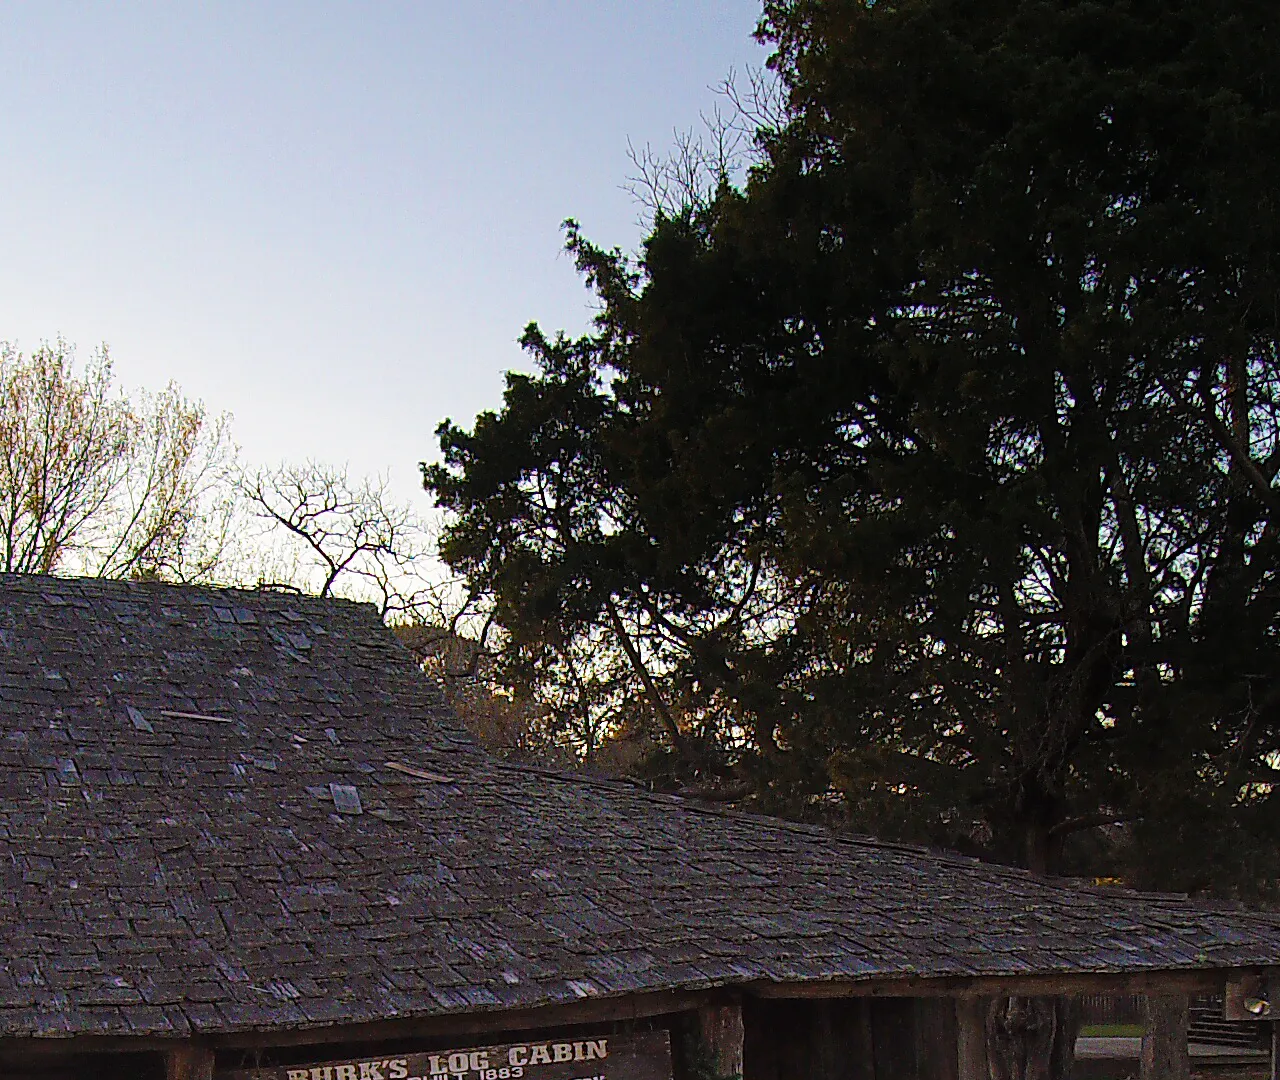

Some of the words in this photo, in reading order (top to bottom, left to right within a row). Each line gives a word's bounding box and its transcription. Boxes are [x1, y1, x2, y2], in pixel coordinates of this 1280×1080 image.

[428, 1051, 489, 1076] LOG
[508, 1039, 608, 1067] CABIN
[479, 1066, 524, 1080] 1883
